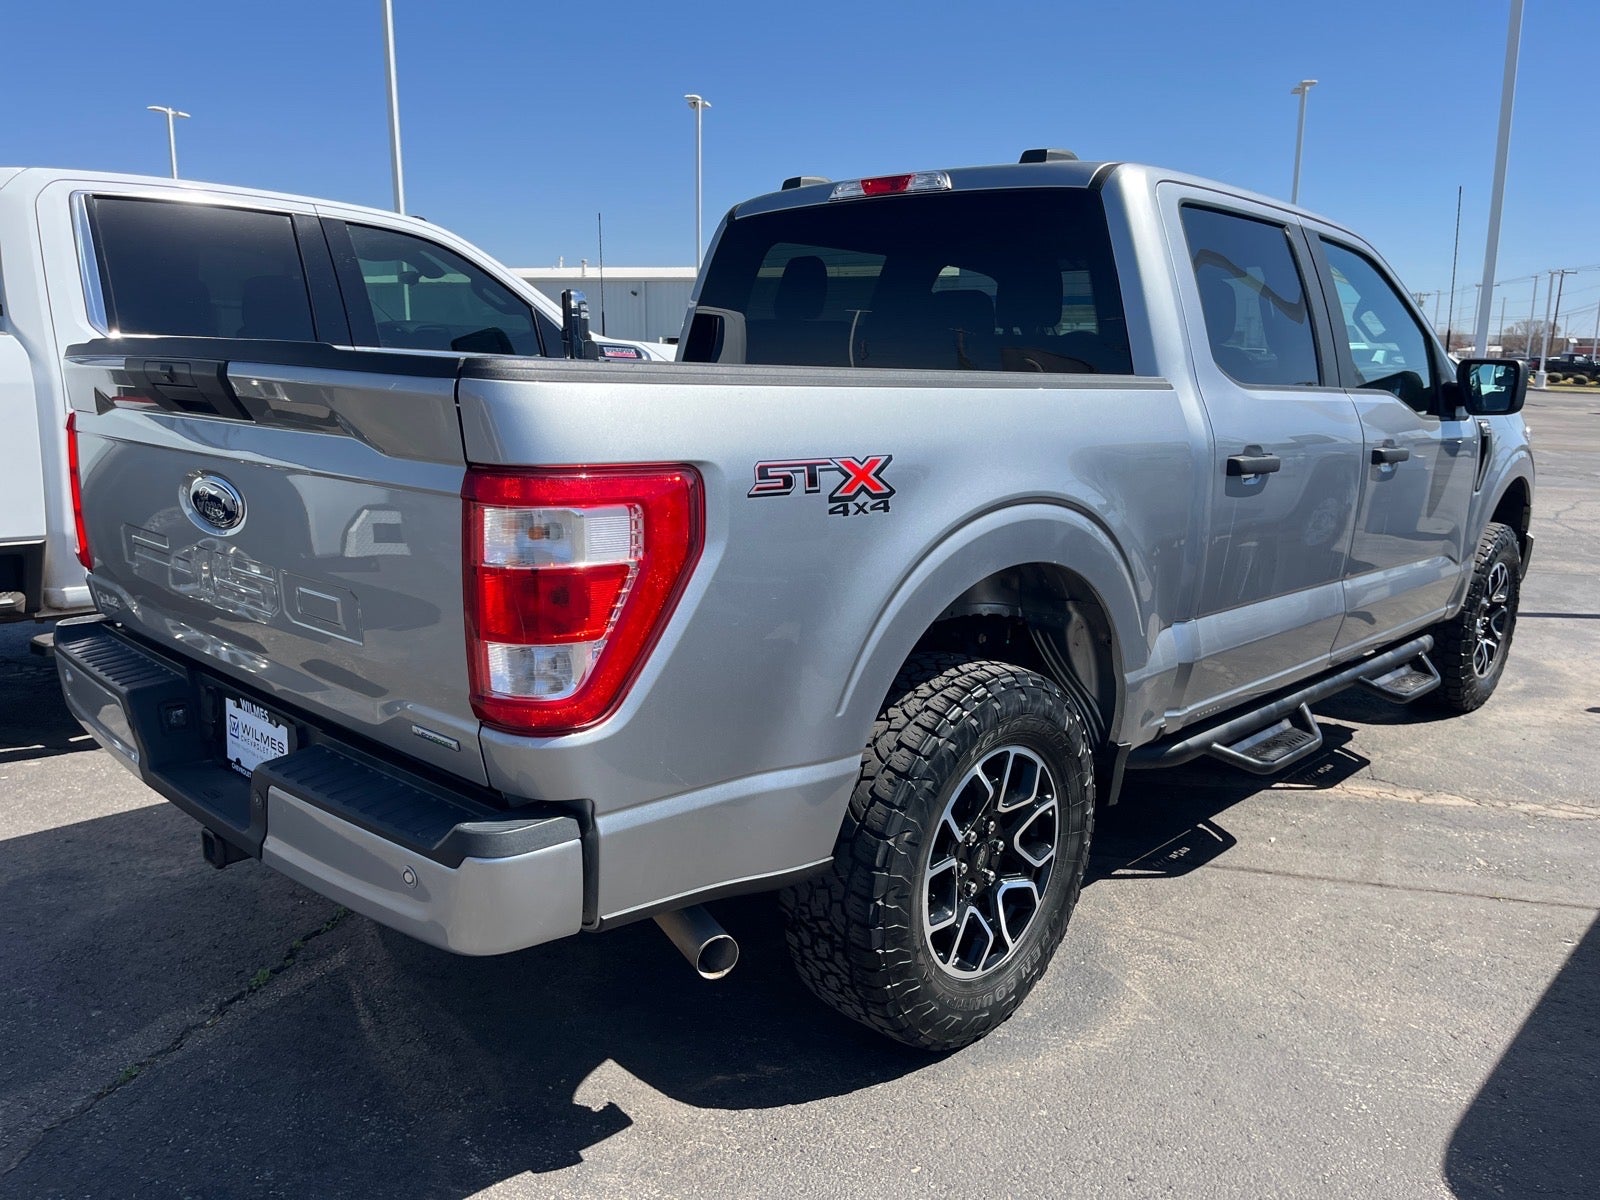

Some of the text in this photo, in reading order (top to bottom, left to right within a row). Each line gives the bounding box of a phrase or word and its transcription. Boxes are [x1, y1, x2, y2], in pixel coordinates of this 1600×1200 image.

[747, 455, 896, 503] STX
[240, 698, 269, 723] WILMES
[241, 721, 285, 755] WILMES
